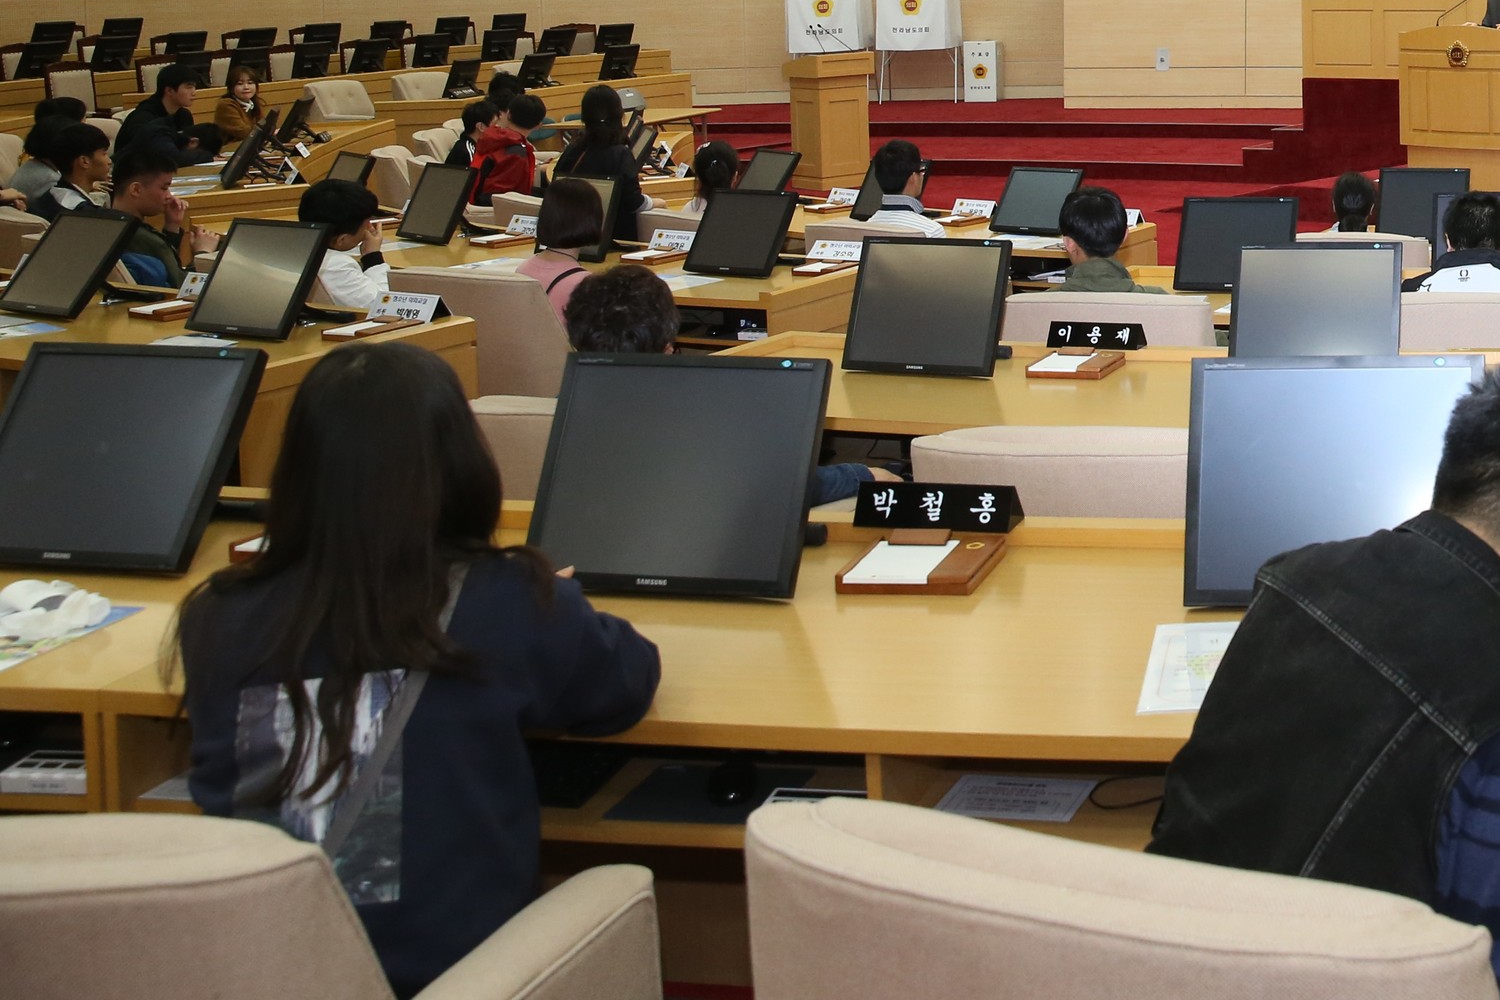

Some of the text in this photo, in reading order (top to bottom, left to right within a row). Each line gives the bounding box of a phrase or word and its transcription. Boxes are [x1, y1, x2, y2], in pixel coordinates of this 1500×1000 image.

[1058, 325, 1130, 345] 이용재
[873, 488, 997, 524] 박철홍
[636, 578, 667, 586] SAMSUNG
